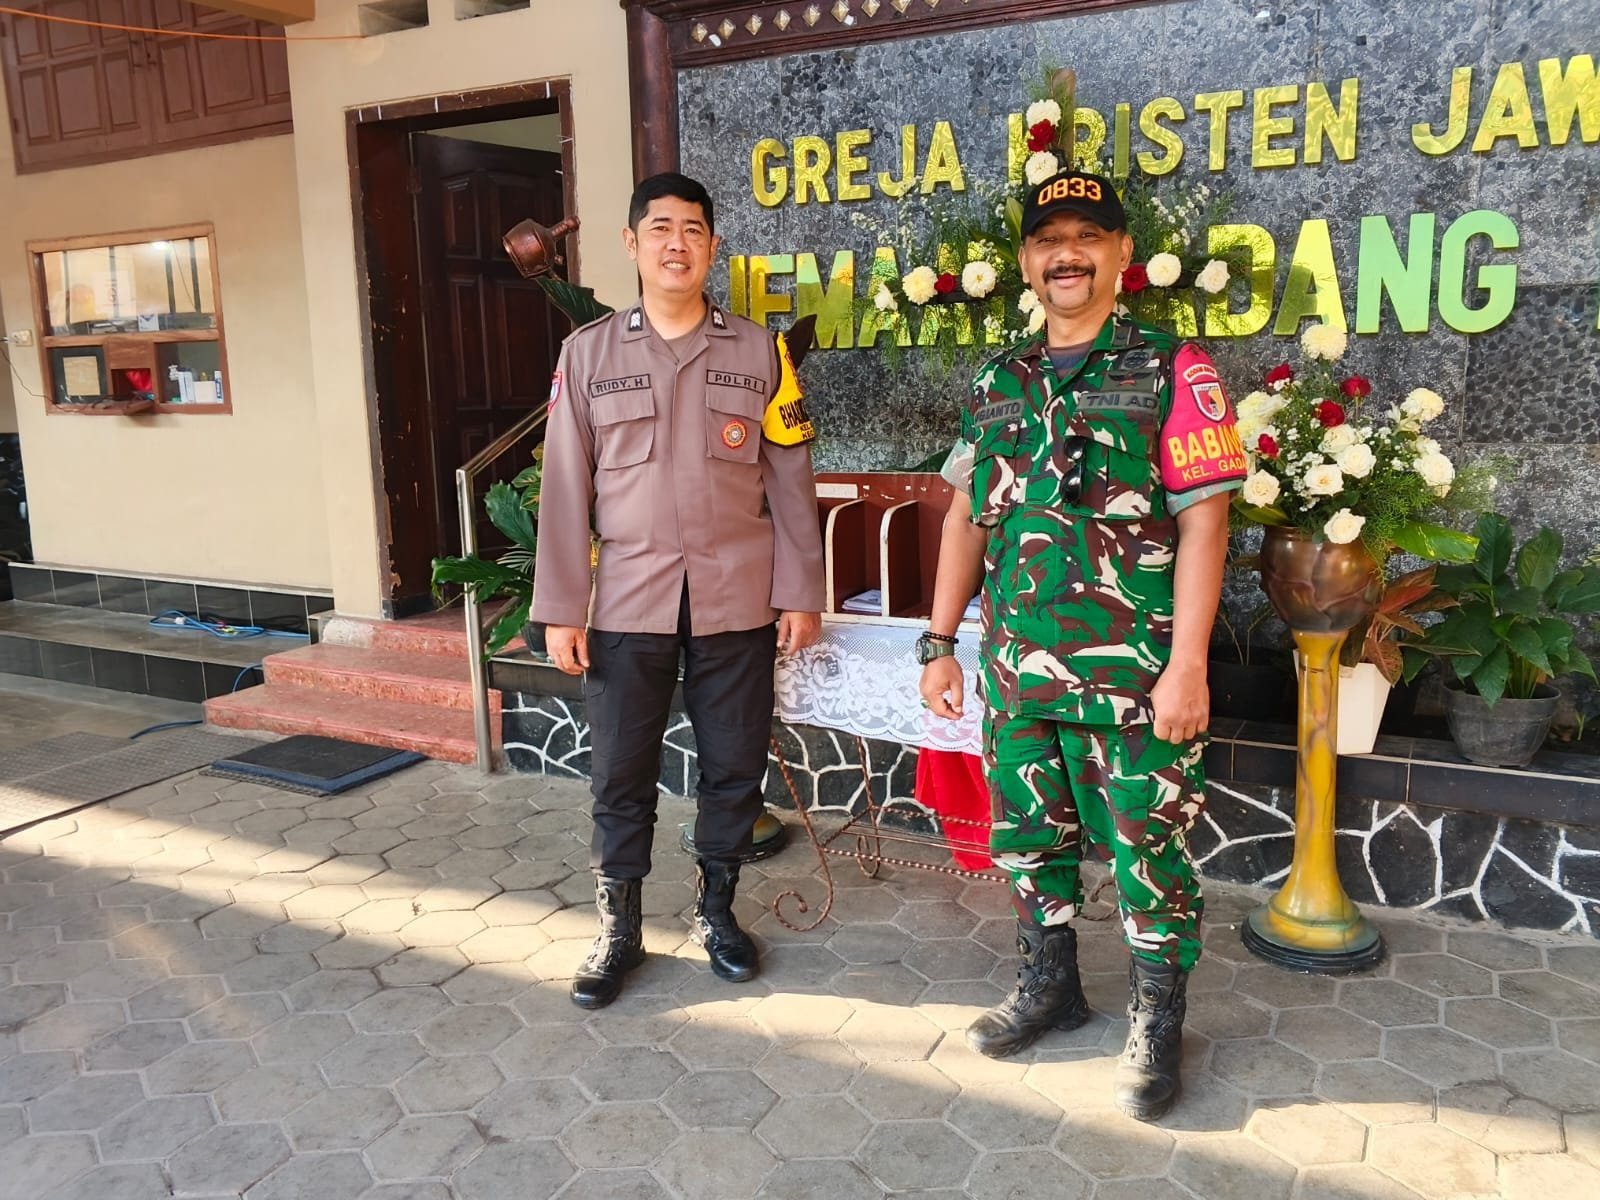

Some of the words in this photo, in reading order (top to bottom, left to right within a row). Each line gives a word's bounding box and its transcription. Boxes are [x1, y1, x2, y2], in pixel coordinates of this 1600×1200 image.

[751, 121, 966, 208] GREJA
[1411, 54, 1600, 156] JAW
[1037, 177, 1102, 206] 0833
[634, 378, 644, 388] H
[714, 373, 759, 389] POLRI
[1087, 393, 1120, 406] TNI
[1125, 394, 1158, 409] AD
[1182, 465, 1214, 482] KEL.
